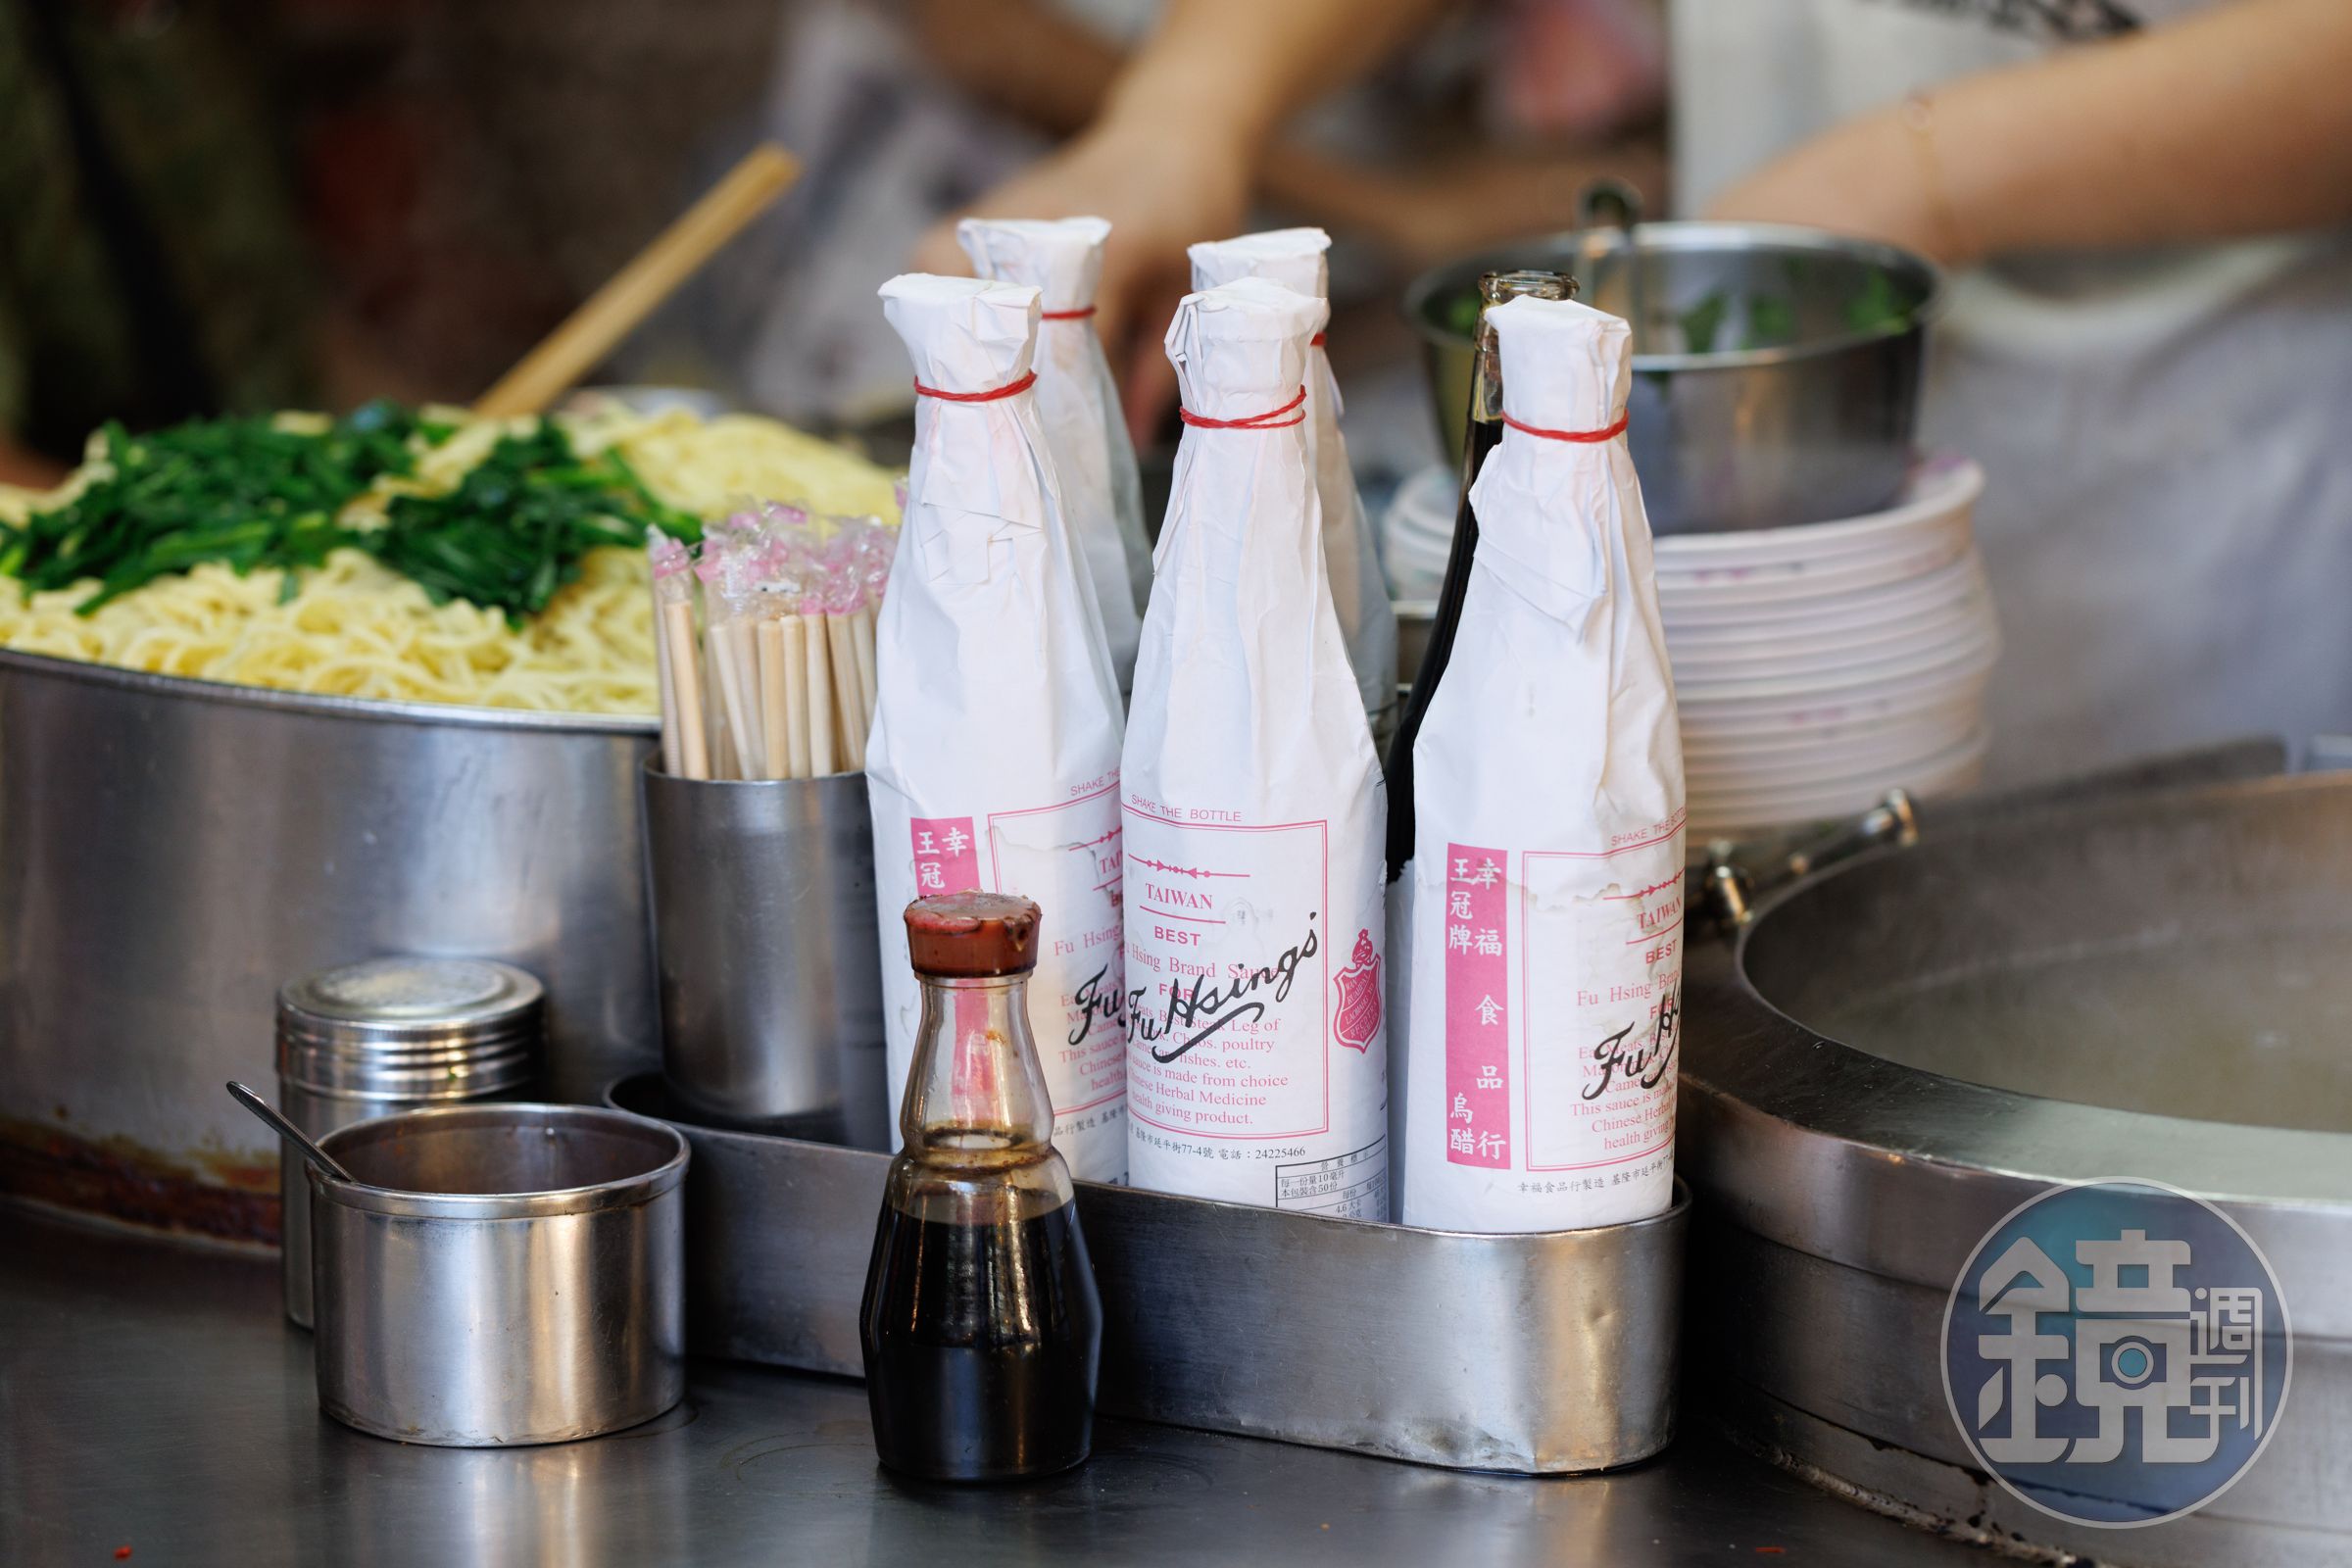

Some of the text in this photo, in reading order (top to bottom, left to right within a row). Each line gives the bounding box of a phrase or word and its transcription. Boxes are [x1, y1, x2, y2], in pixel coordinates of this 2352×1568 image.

[1070, 775, 1104, 797] SHAKE
[1131, 794, 1242, 822] SHAKE THE BOTTLE
[1611, 828, 1647, 847] SHAKE
[1145, 882, 1213, 910] TAIWAN
[1054, 940, 1075, 957] Fu
[1082, 923, 1121, 950] Hsing
[1153, 925, 1201, 948] BEST
[1132, 943, 1161, 972] Hsing
[1169, 956, 1216, 978] Brand
[1645, 938, 1678, 965] BEST
[1577, 990, 1599, 1007] Fu
[1609, 982, 1652, 1003] Hsing
[1231, 1018, 1259, 1034] Leg
[1263, 1017, 1281, 1032] of
[1059, 1049, 1086, 1063] This
[1222, 1038, 1275, 1054] poultry
[1225, 1058, 1251, 1069] etc.
[1164, 1069, 1198, 1085] made
[1202, 1073, 1236, 1088] from
[1240, 1074, 1289, 1088] choice
[1155, 1081, 1195, 1102] Herbal
[1200, 1090, 1267, 1106] Medicine
[1570, 1101, 1601, 1116] This
[1605, 1096, 1641, 1113] sauce
[1642, 1090, 1652, 1104] is
[1155, 1100, 1192, 1123] giving
[1196, 1110, 1254, 1126] product.
[1592, 1112, 1642, 1134] Chinese
[1604, 1129, 1642, 1151] health
